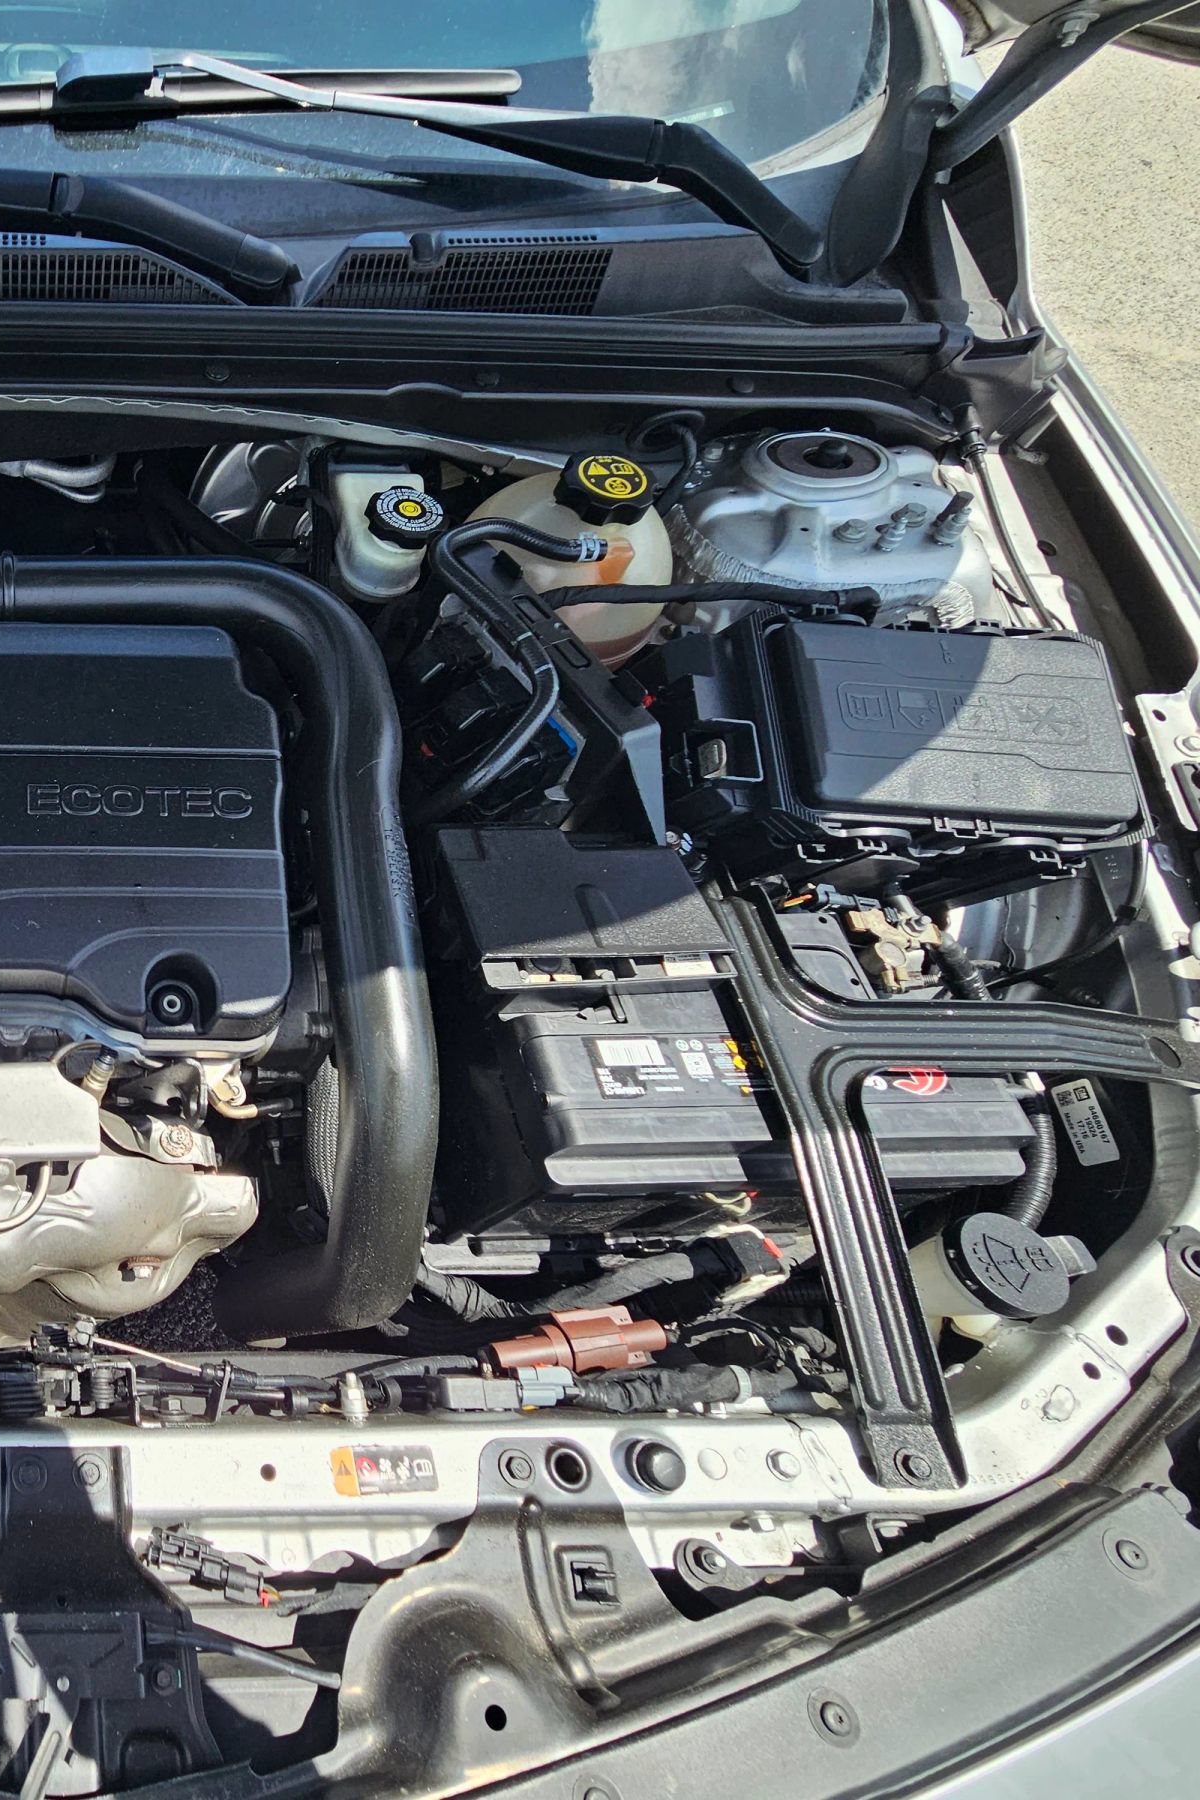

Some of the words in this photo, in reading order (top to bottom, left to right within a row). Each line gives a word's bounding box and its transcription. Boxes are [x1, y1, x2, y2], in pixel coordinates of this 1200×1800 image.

[26, 784, 253, 819] ECOTEC
[1064, 1112, 1075, 1130] Made
[1075, 1140, 1086, 1154] USA
[1085, 1117, 1098, 1138] 19324
